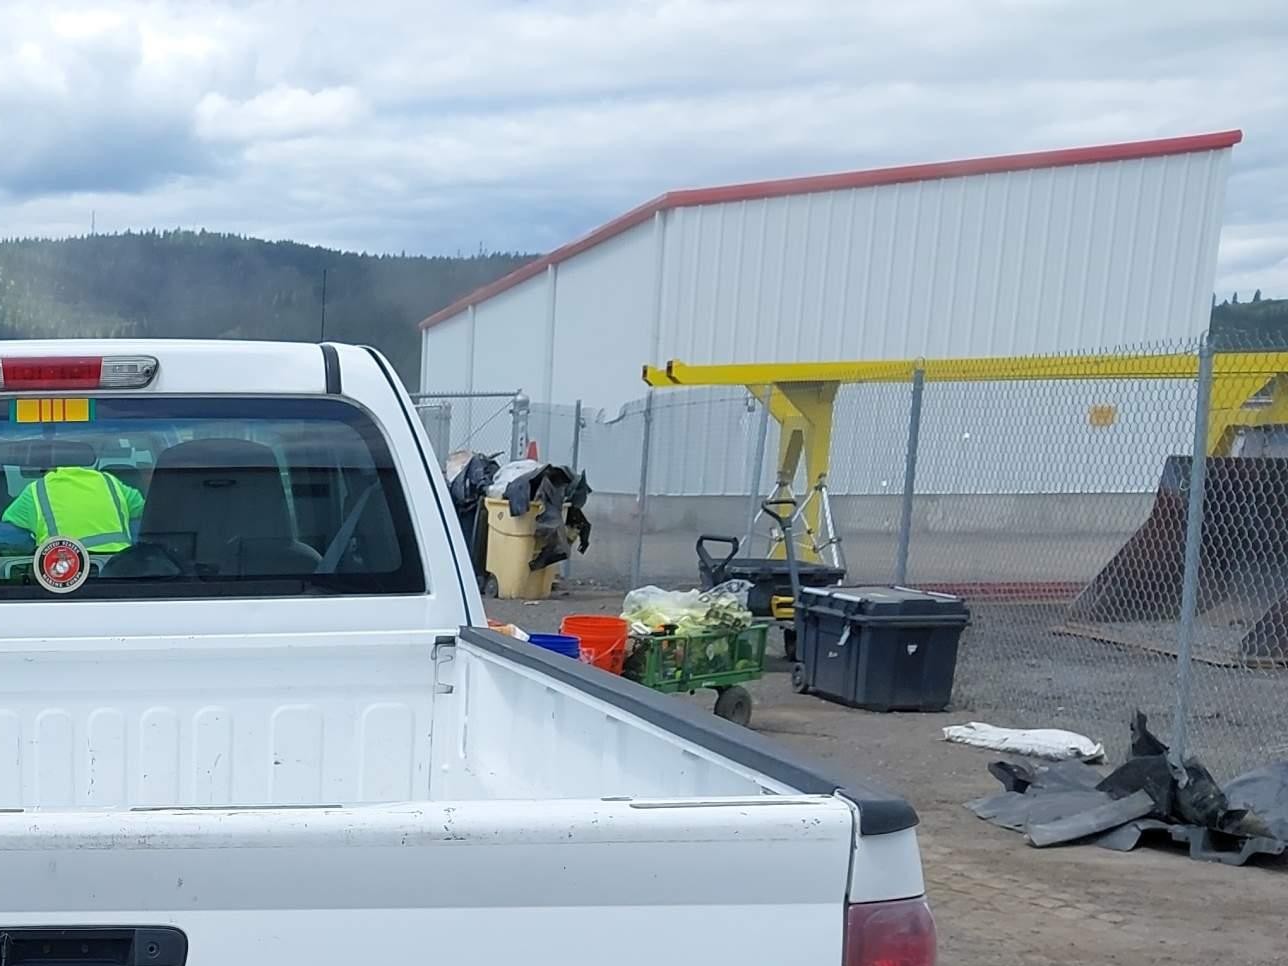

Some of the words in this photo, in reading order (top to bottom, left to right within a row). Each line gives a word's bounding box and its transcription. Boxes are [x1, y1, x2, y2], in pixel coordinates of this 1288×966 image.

[42, 541, 60, 555] UNITED
[62, 541, 80, 553] STATES
[42, 573, 63, 588] MARINE
[65, 571, 82, 587] CORPS
